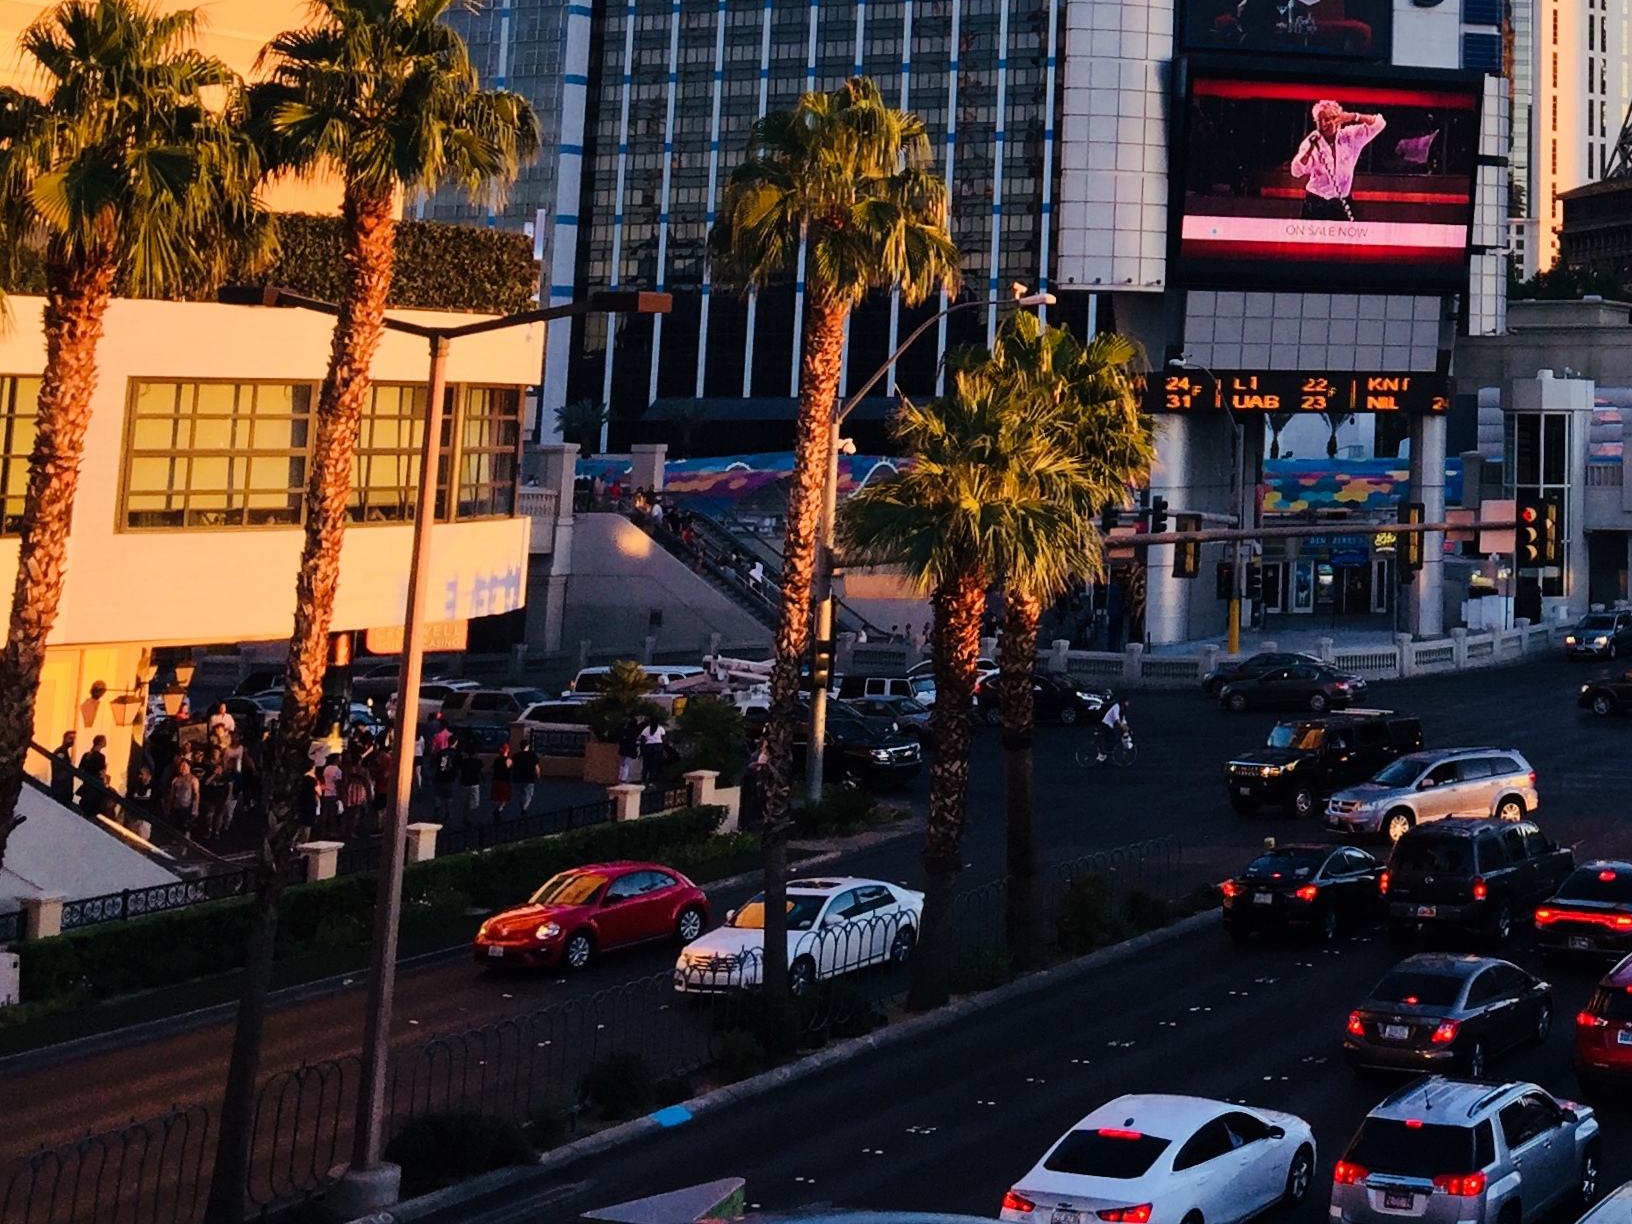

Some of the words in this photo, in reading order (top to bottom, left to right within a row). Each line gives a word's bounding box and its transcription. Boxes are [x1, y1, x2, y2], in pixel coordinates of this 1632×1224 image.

[1286, 225, 1305, 236] ON
[1308, 225, 1336, 236] SALE
[1338, 227, 1369, 237] NOW
[1165, 377, 1190, 391] 24
[1302, 378, 1328, 391] 22
[1166, 395, 1192, 408] 31
[1232, 395, 1280, 408] UAB
[1301, 396, 1327, 409] 23
